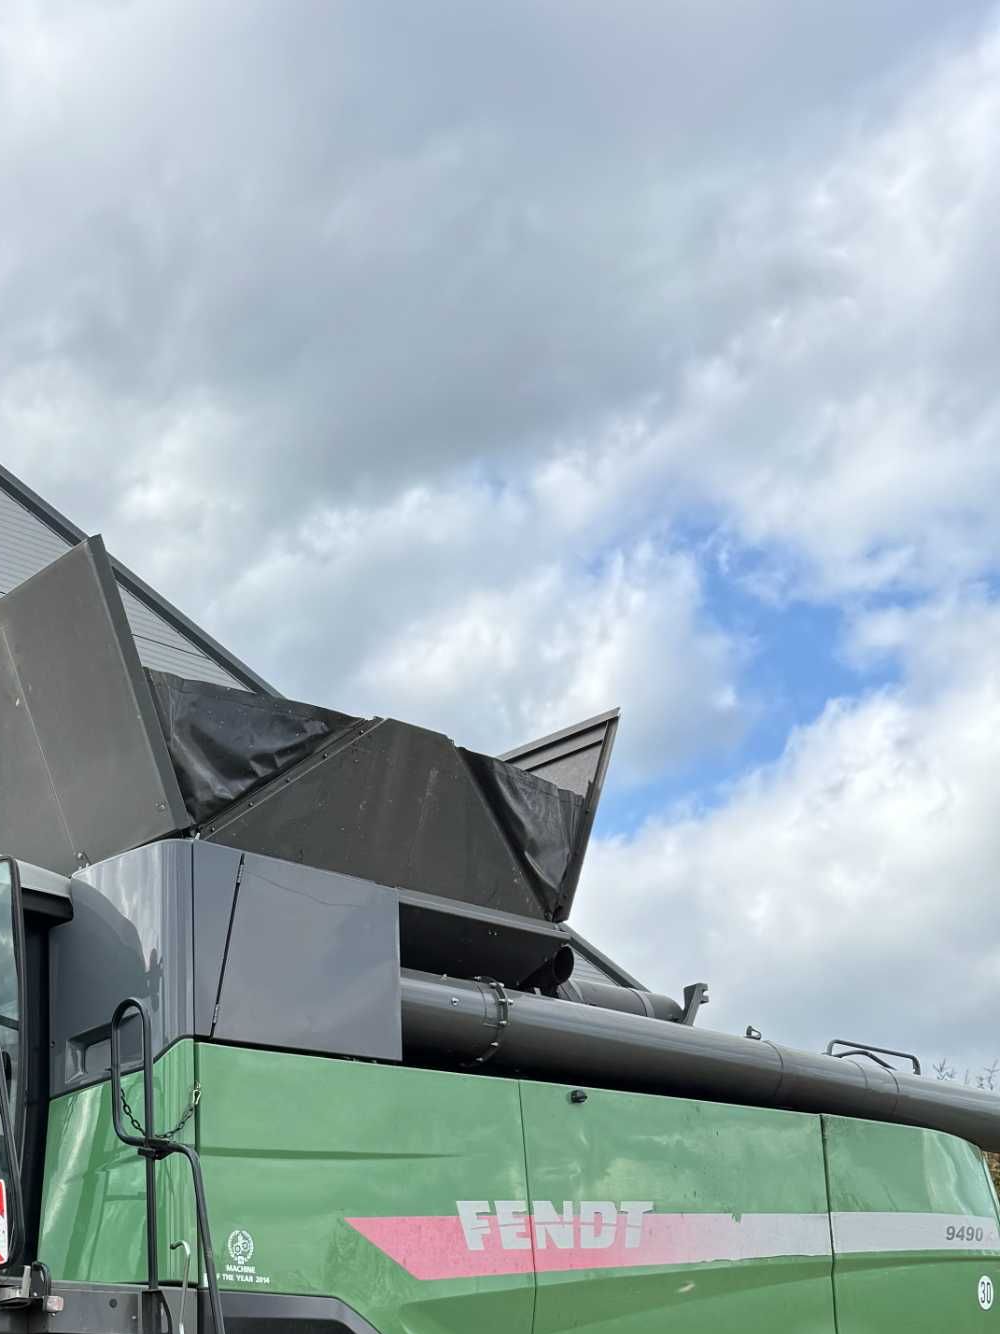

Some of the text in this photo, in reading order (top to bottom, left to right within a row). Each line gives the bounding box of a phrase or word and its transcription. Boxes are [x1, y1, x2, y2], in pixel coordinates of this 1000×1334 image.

[456, 1200, 654, 1250] FENDT
[946, 1225, 984, 1242] 9490
[226, 1264, 256, 1273] MACHINE
[222, 1273, 234, 1281] THE
[236, 1274, 254, 1283] YEAR
[980, 1281, 992, 1304] 30
